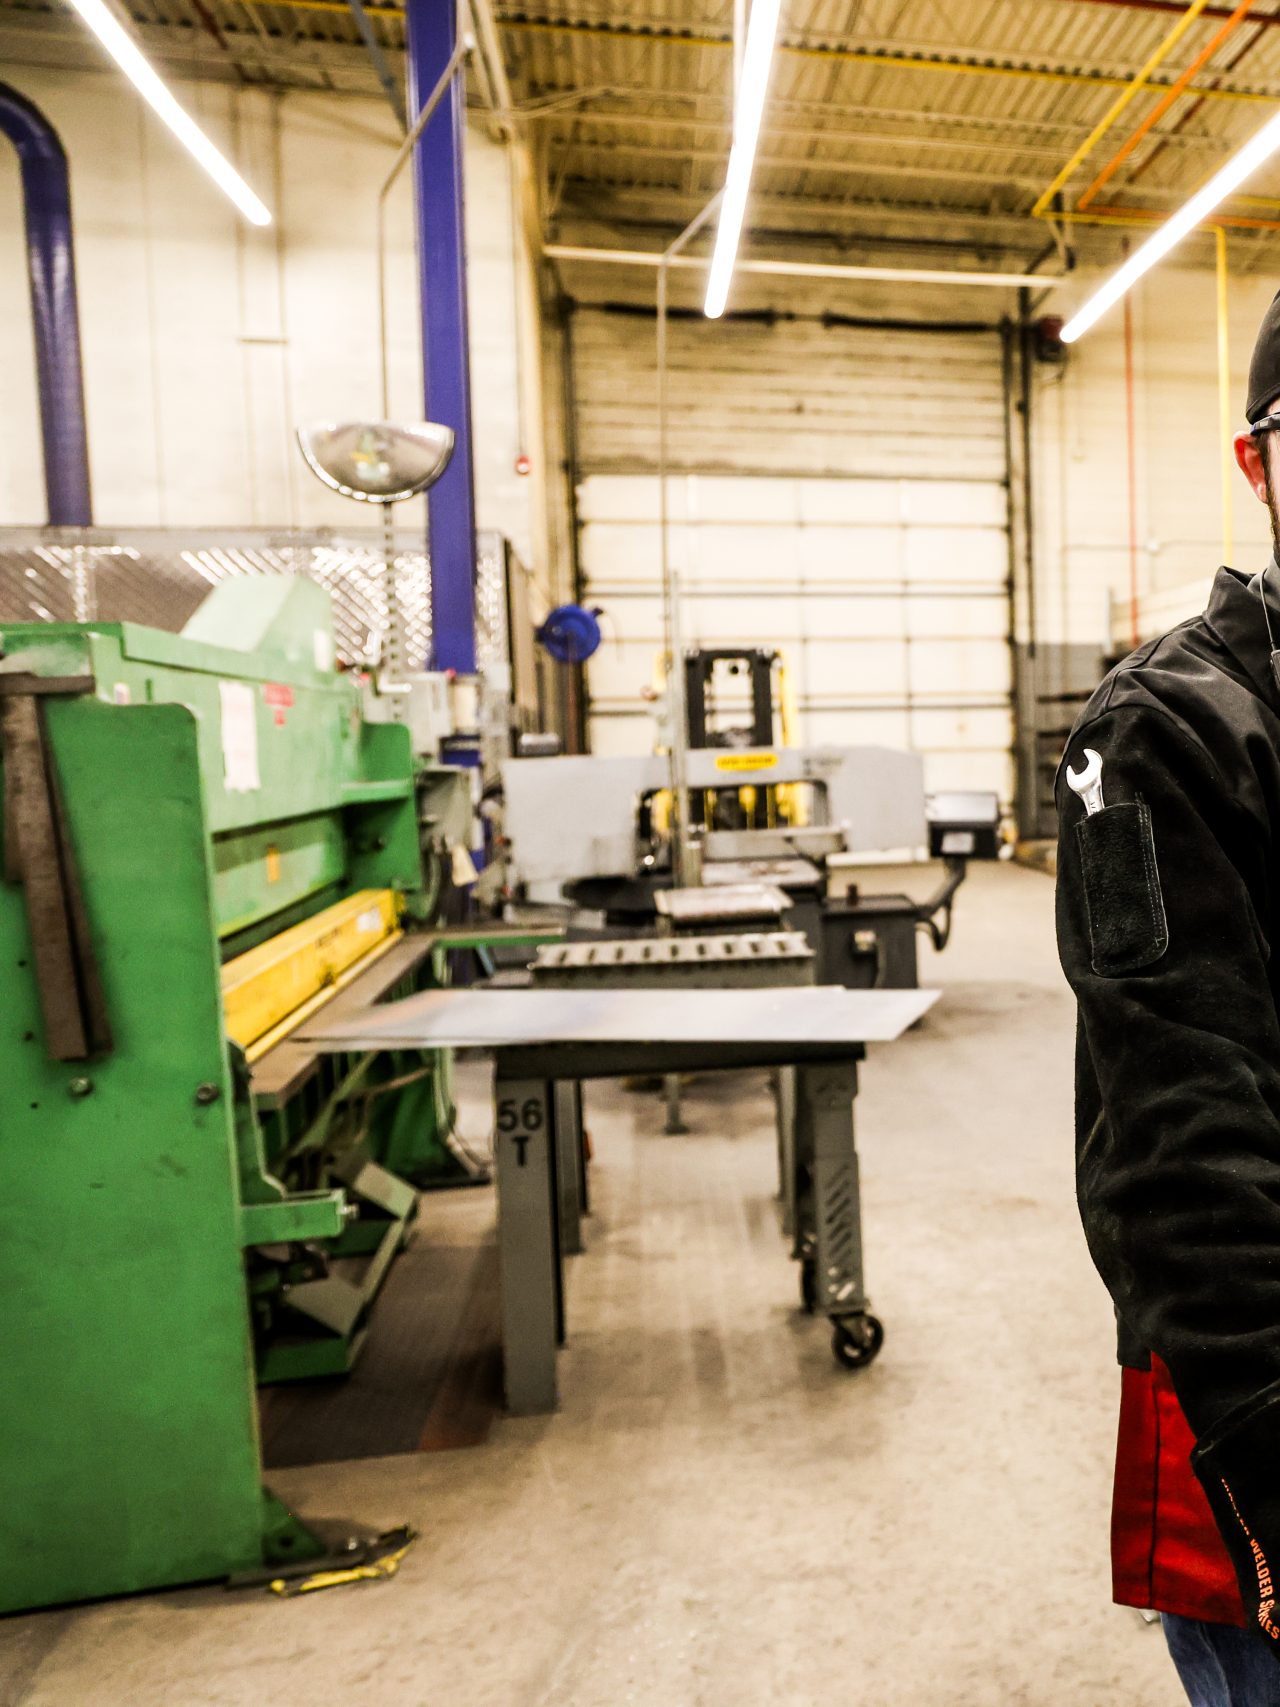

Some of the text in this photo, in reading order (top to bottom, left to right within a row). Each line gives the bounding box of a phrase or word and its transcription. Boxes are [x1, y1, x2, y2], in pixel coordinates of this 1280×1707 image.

[497, 1098, 543, 1132] 56
[513, 1135, 530, 1167] T
[1250, 1538, 1275, 1598] WELDER
